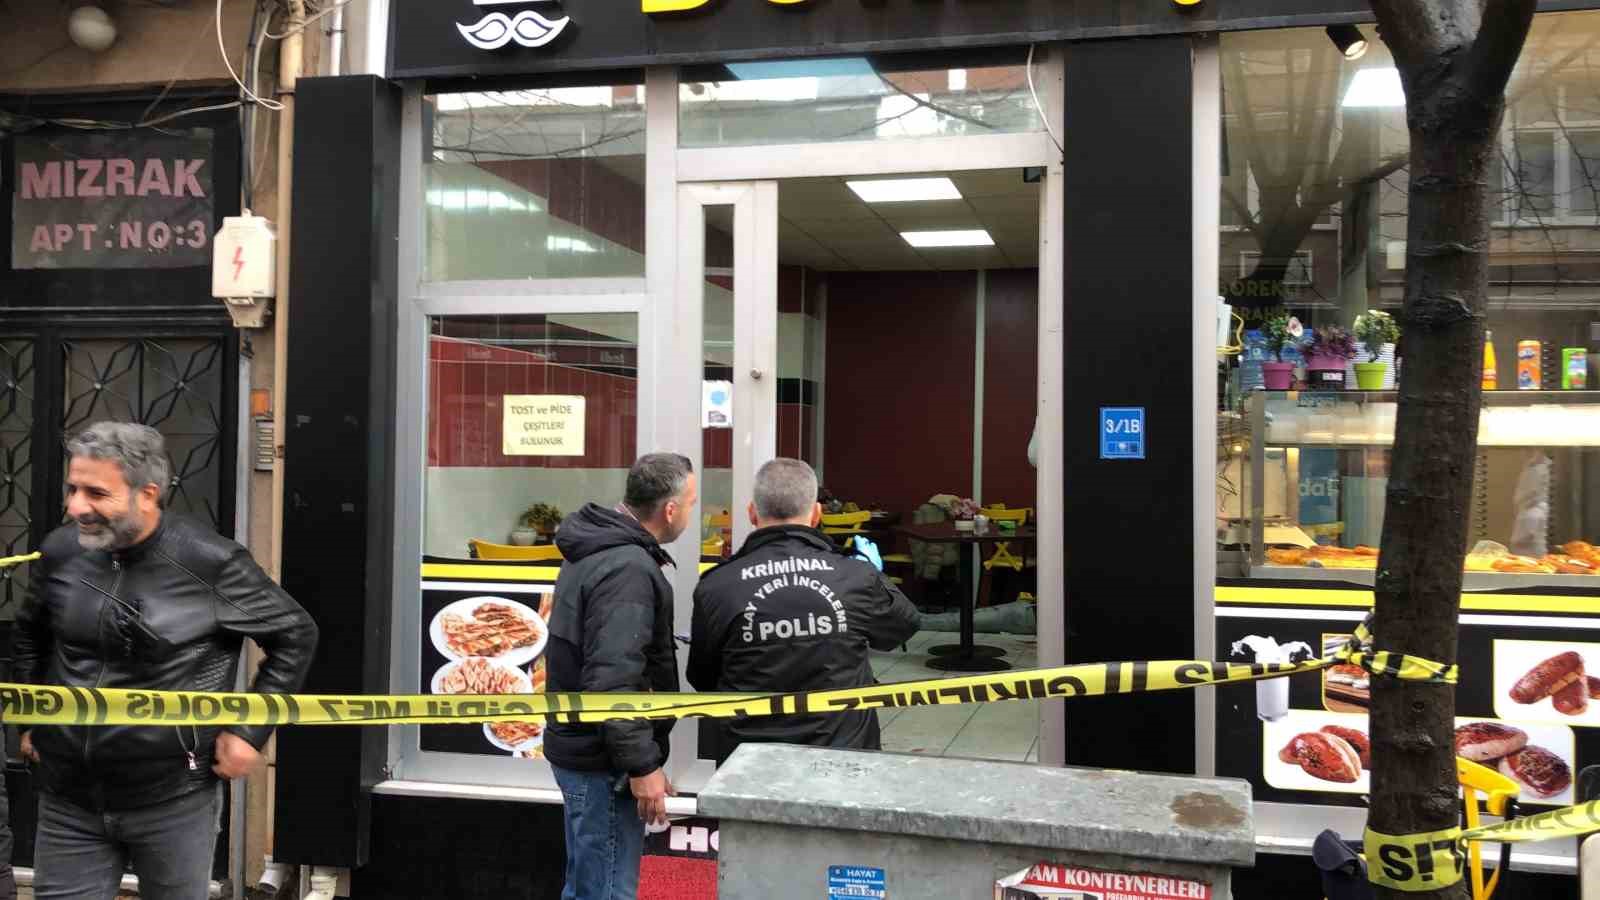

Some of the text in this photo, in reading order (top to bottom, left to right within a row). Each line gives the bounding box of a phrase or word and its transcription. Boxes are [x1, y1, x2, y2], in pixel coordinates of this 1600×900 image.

[20, 158, 206, 199] MIZRAK
[510, 405, 534, 415] TOST
[536, 406, 548, 415] ve
[1105, 418, 1140, 434] 3/1B
[741, 556, 834, 580] KRİMİNAL
[742, 573, 848, 642] OLAY YERİ İNCELEME
[759, 612, 833, 641] POLİS
[847, 869, 877, 878] HAYAT
[1025, 863, 1059, 884] AM
